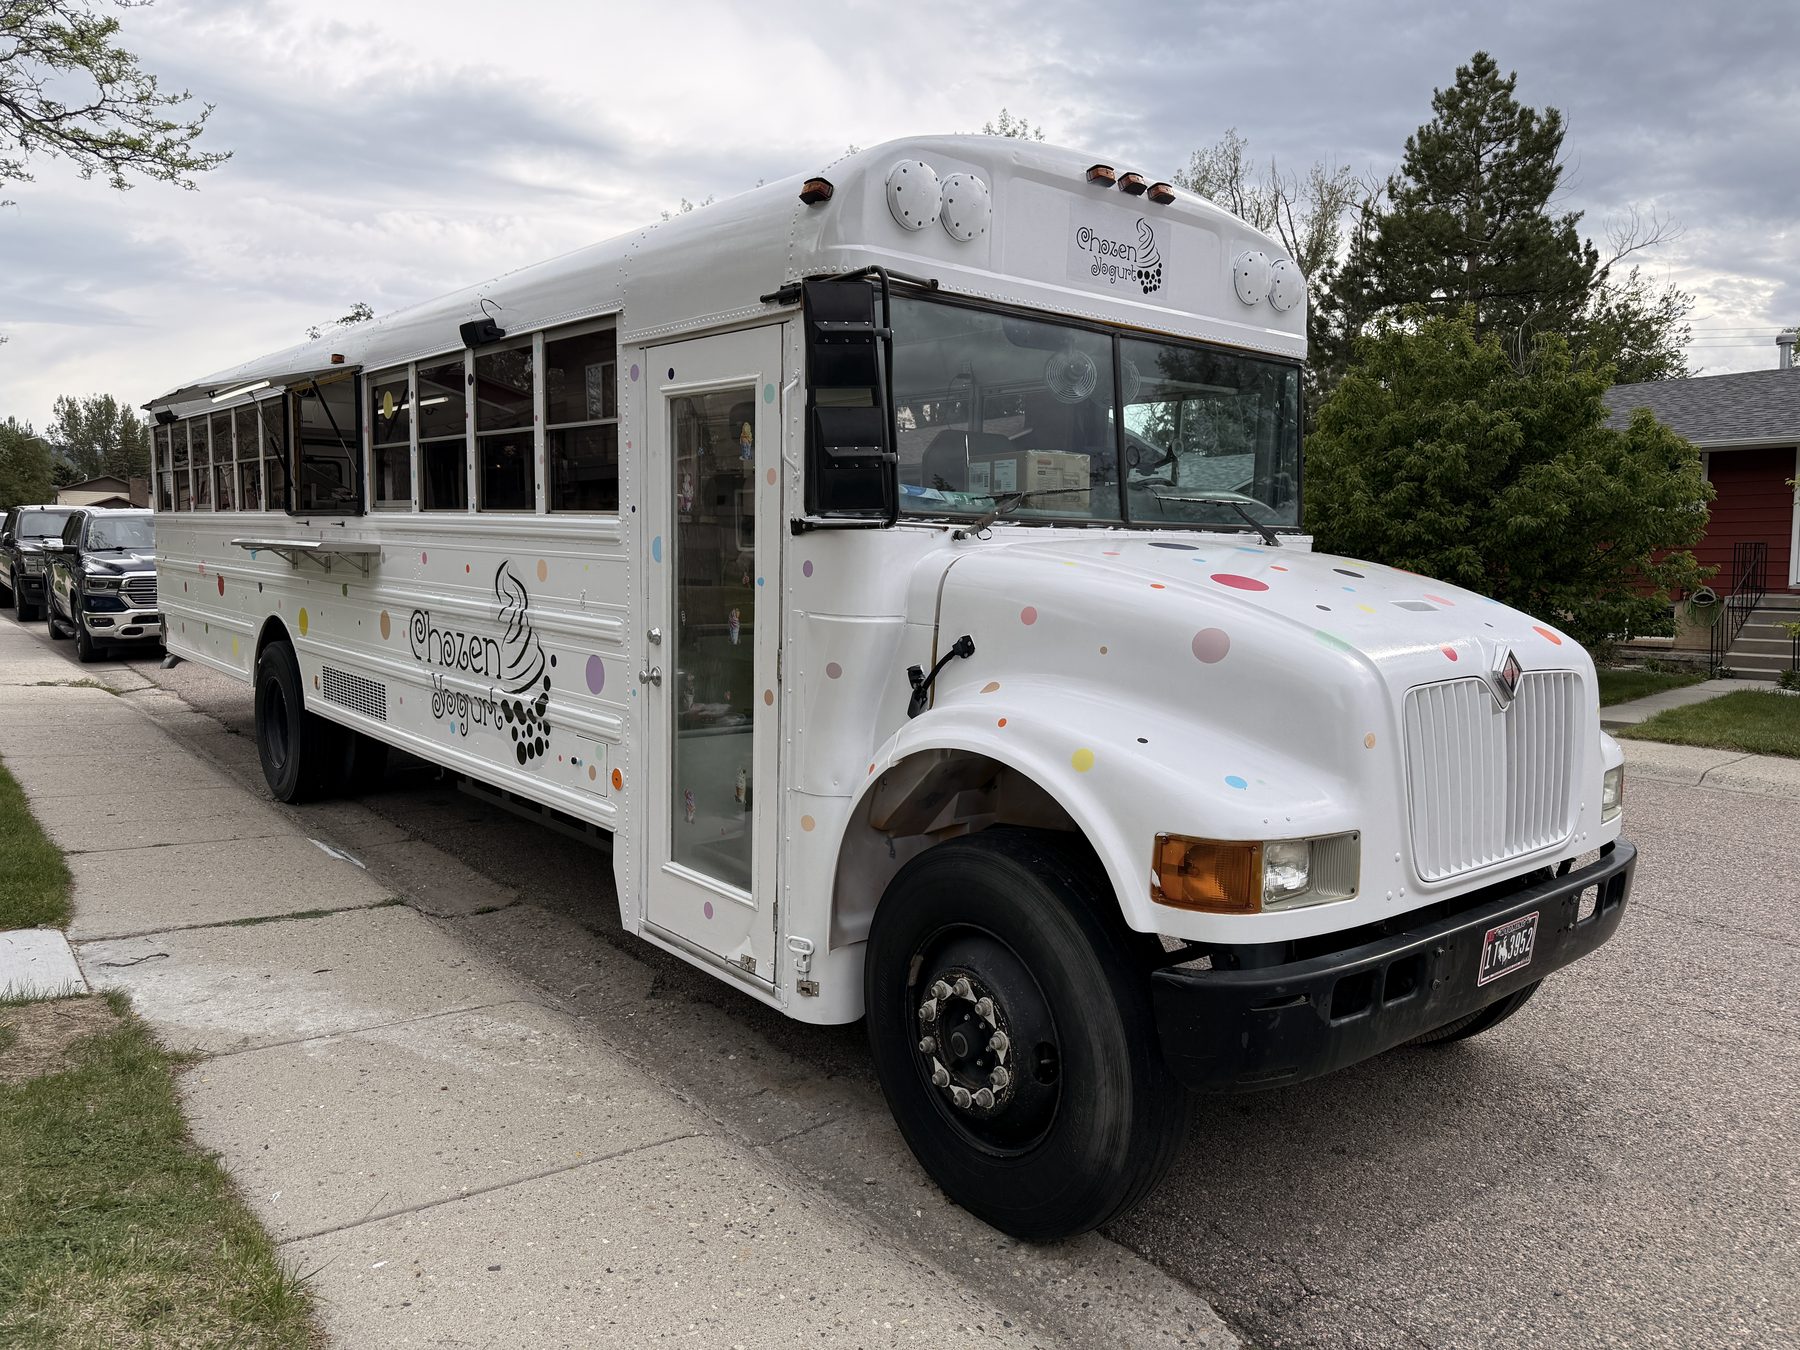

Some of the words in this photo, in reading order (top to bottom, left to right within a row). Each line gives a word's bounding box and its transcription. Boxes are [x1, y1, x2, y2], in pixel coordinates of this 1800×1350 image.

[1077, 226, 1137, 263] Chozen
[1091, 255, 1137, 284] Yogurt
[410, 609, 502, 680] Chozen
[432, 672, 503, 737] Yogurt
[1507, 927, 1533, 960] 3952
